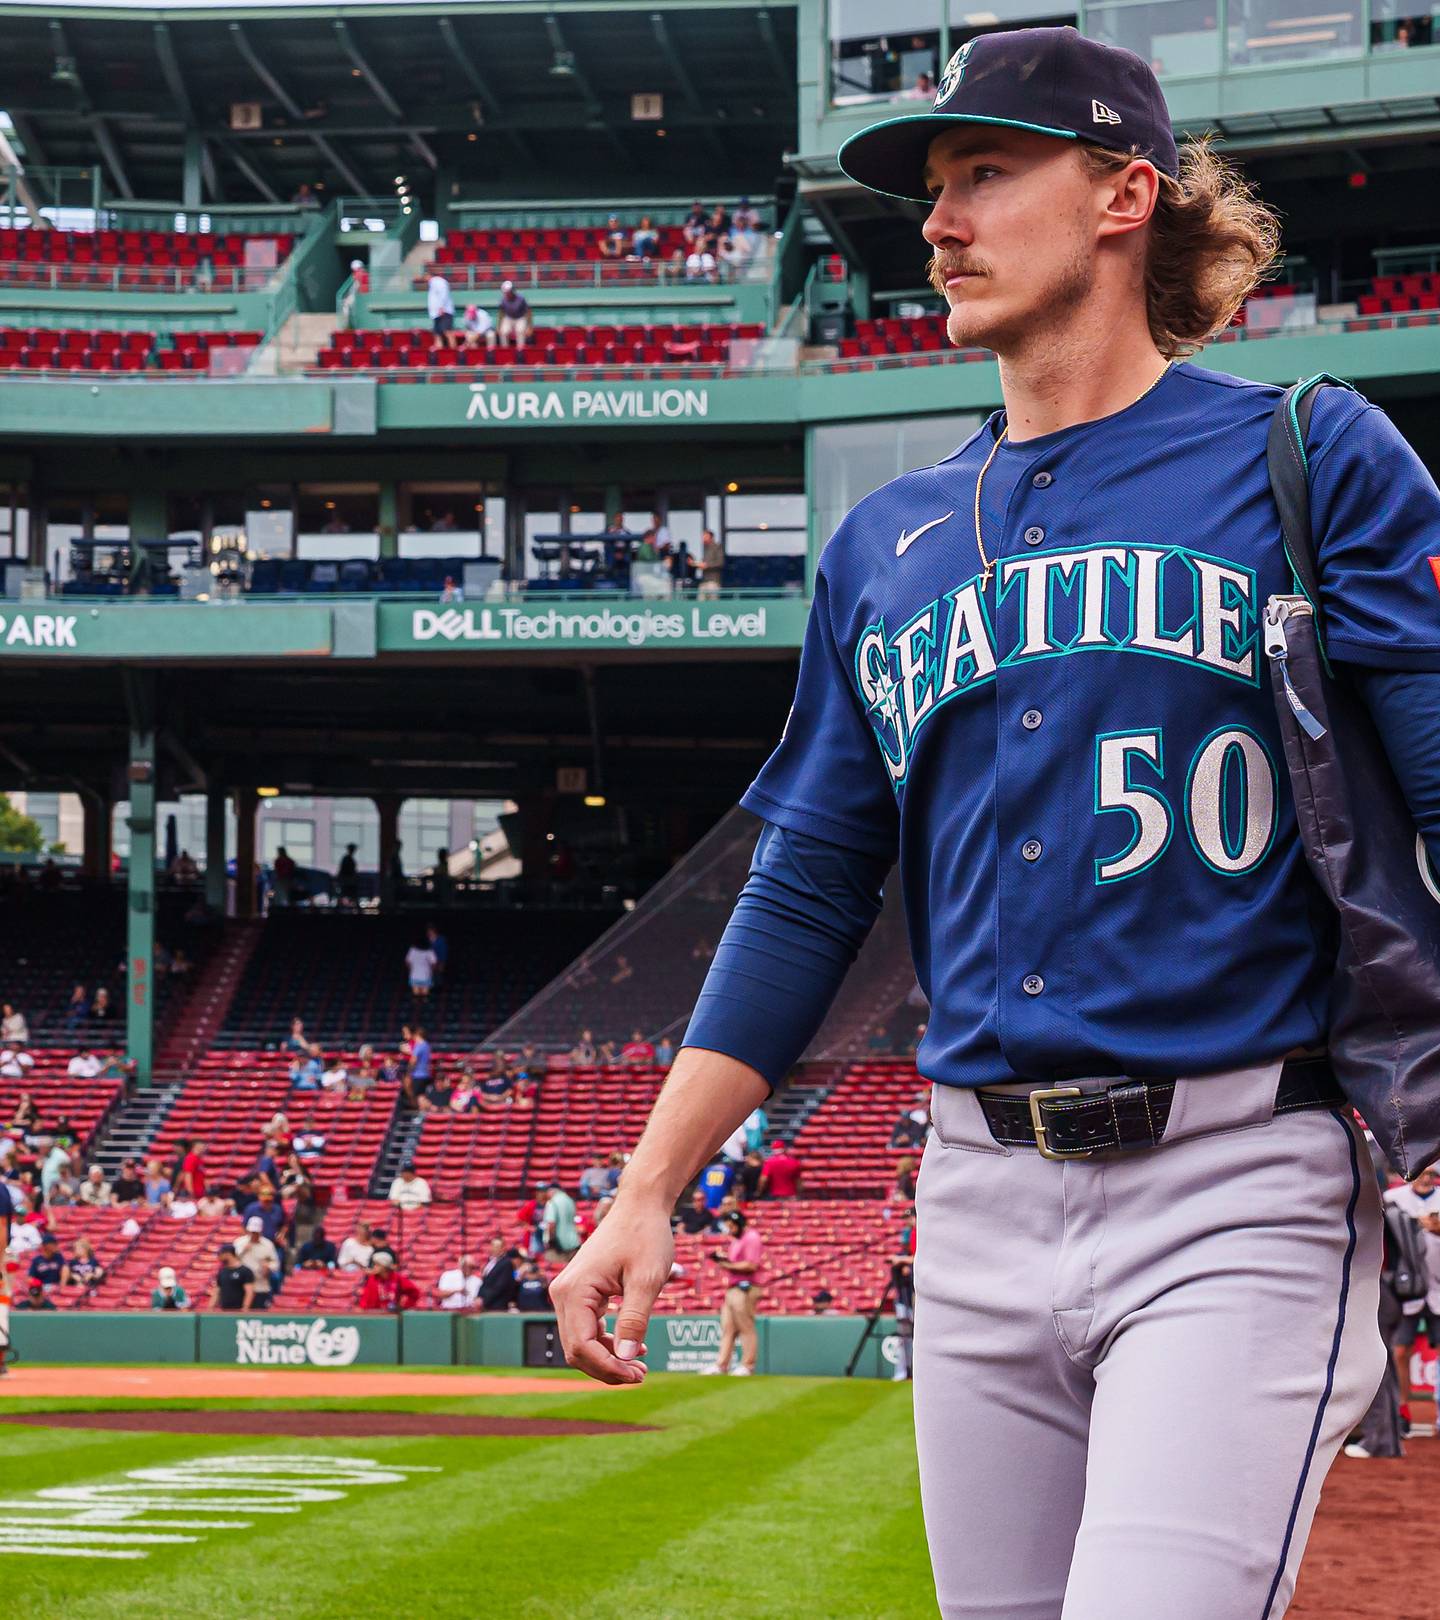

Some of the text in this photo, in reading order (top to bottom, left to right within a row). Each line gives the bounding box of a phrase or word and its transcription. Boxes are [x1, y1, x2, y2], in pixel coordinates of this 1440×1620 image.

[573, 389, 708, 417] PAVILION
[412, 607, 766, 644] DELL Technologies Level
[855, 542, 1261, 795] SEATTLE
[1095, 724, 1279, 886] 50
[236, 1319, 309, 1343] Ninety
[236, 1340, 306, 1363] Nine
